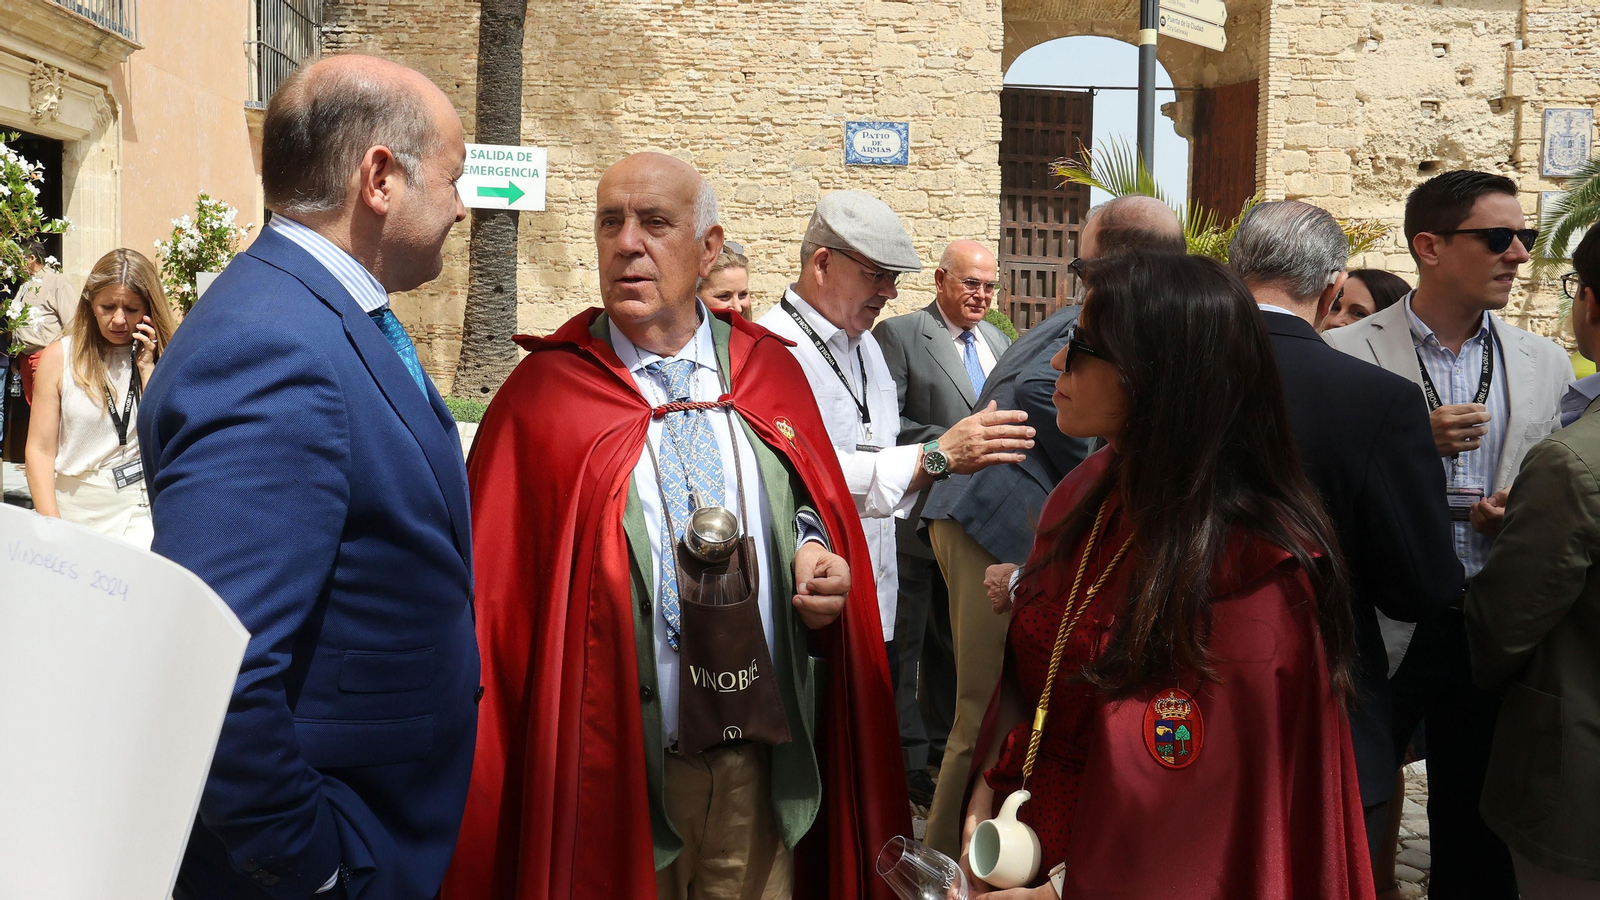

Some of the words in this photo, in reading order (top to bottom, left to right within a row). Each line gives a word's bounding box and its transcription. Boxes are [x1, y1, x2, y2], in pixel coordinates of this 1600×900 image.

[1167, 15, 1180, 26] Puerta
[1181, 19, 1186, 27] de
[1190, 22, 1204, 32] Ciudad
[470, 149, 514, 161] SALIDA
[517, 152, 533, 162] DE
[462, 164, 540, 178] EMERGENCIA
[8, 540, 78, 580] VINOBLES
[90, 570, 129, 602] 2024
